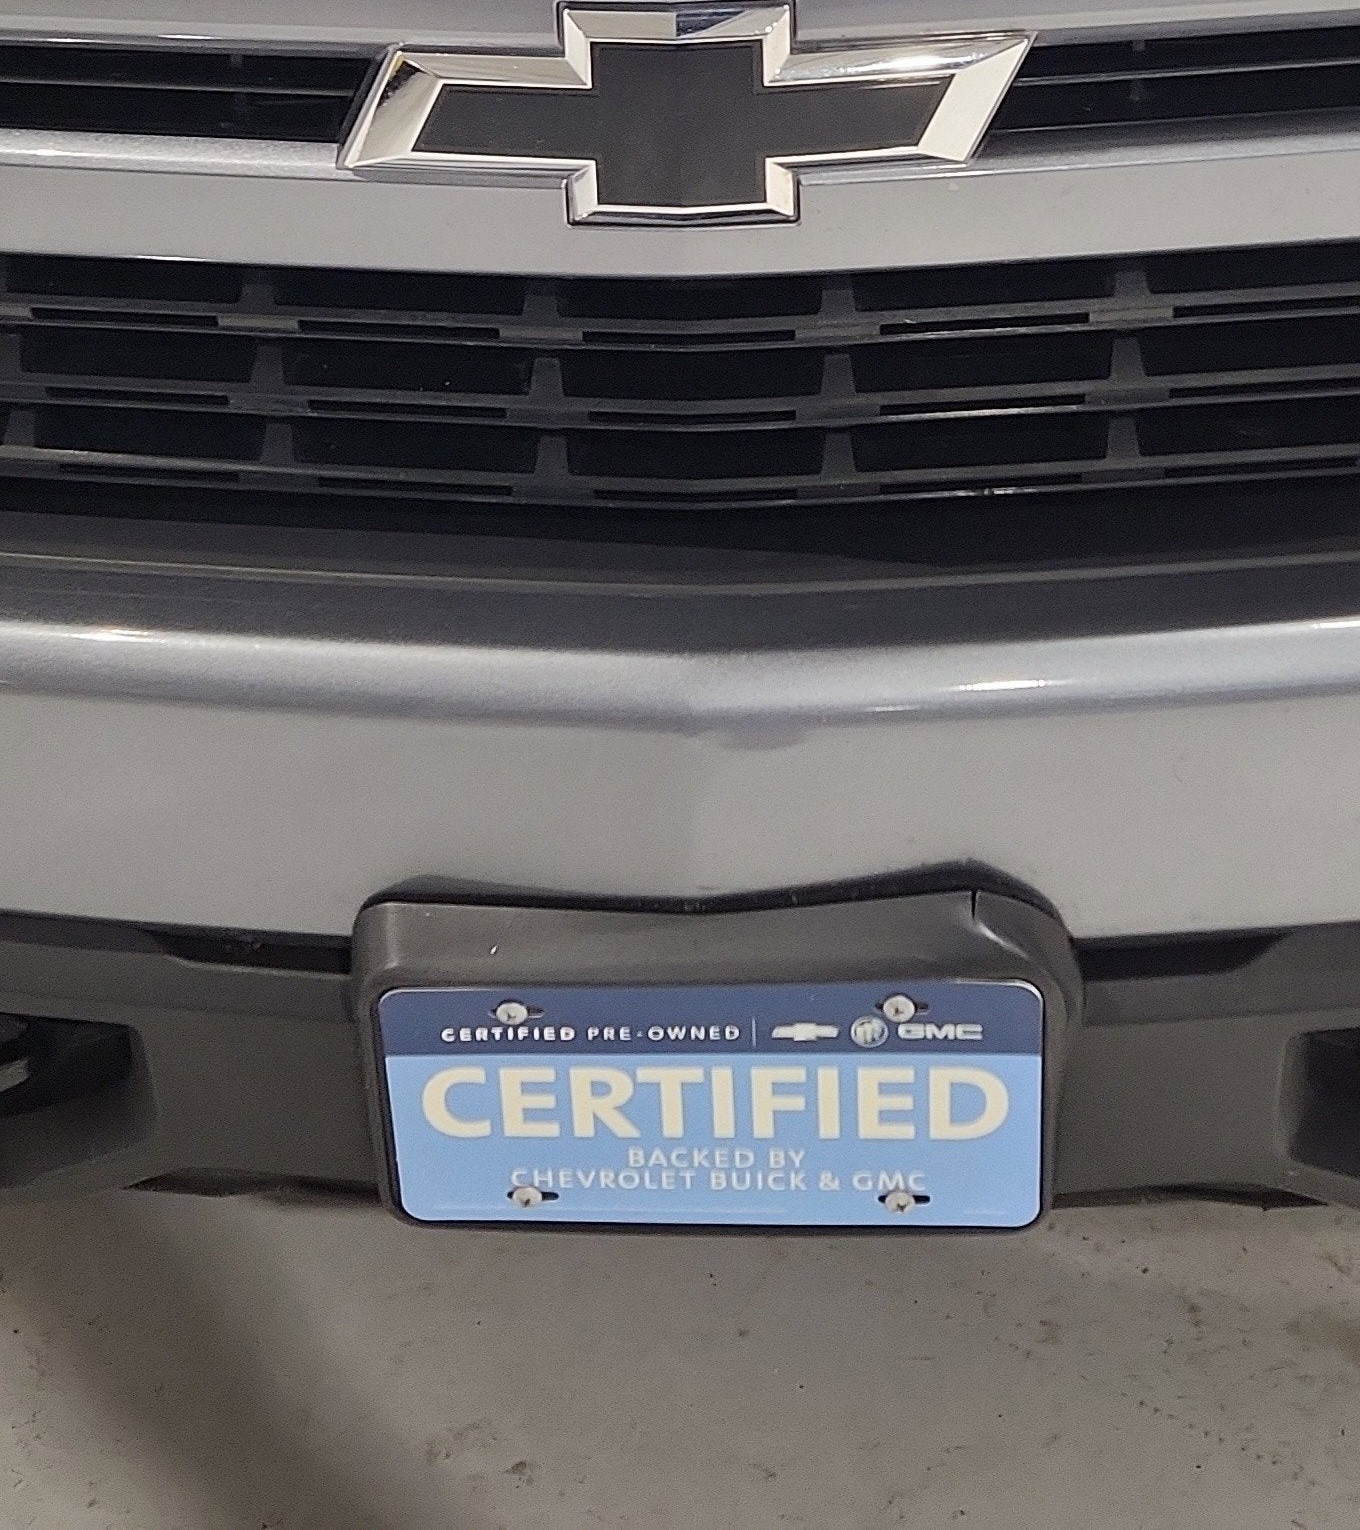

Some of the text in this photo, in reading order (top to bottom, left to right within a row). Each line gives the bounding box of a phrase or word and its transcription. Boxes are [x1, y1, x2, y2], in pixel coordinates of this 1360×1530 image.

[440, 1022, 983, 1043] CERTIFIED PRE-OWNED GMC
[421, 1065, 1010, 1140] CERTIFIED
[627, 1146, 805, 1169] BACKED BY
[510, 1169, 926, 1191] CHEVROLET BUICK & GMC
